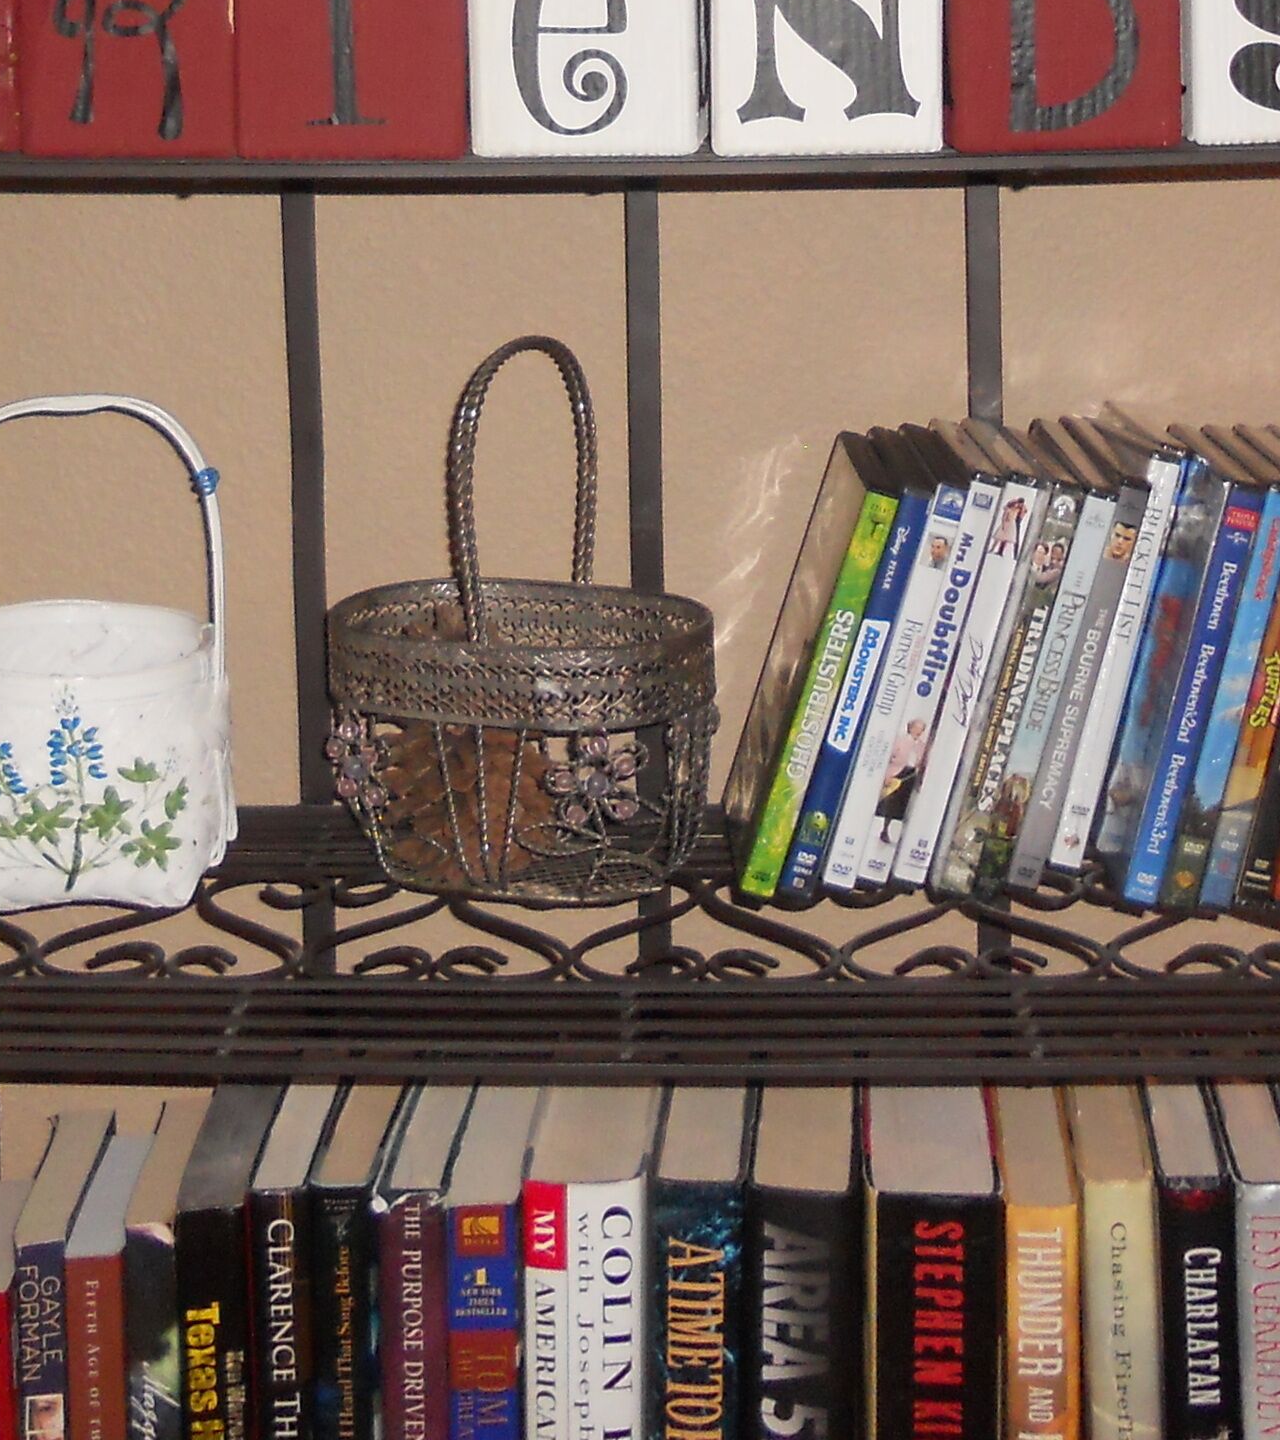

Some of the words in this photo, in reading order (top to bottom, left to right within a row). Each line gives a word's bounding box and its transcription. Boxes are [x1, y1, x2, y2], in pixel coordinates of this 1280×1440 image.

[889, 522, 911, 558] Disney
[953, 532, 975, 567] Mrs.
[1125, 506, 1164, 595] BUCKET
[881, 560, 897, 590] PIXAR
[1074, 570, 1085, 589] THE
[1207, 560, 1238, 632] Beethoven
[892, 618, 924, 671] Forrest
[915, 567, 973, 701] Doubtfire
[1040, 589, 1087, 680] PRINCESS
[1095, 608, 1108, 629] THE
[1112, 599, 1141, 645] LIST
[1006, 603, 1050, 711] TRADING
[1069, 628, 1101, 702] BOURNE
[785, 606, 856, 783] GHOSTBUSTERS
[875, 669, 907, 718] Gump
[1024, 674, 1061, 735] BRIDE
[832, 715, 852, 744] INC.
[1037, 704, 1081, 810] SUPREMACY
[976, 718, 1017, 814] PLACES
[404, 1203, 421, 1239] THE
[533, 1209, 556, 1259] MY
[335, 1246, 351, 1293] Before
[578, 1213, 595, 1293] with
[668, 1236, 725, 1268] A
[1110, 1222, 1131, 1337] Chasing
[19, 1265, 41, 1382] FORMAN
[40, 1276, 63, 1365] GAYLE
[85, 1280, 100, 1334] FIFTH
[266, 1218, 296, 1382] CLARENCE
[339, 1297, 354, 1334] Song
[401, 1250, 424, 1351] PURPOSE
[455, 1308, 507, 1317] BESTSELLER
[601, 1206, 634, 1393] COLIN
[667, 1271, 725, 1368] TIME
[761, 1221, 831, 1381] AREA
[913, 1220, 965, 1385] STEPHEN
[1016, 1227, 1063, 1376] THUNDER
[1184, 1247, 1223, 1406] CHARLATAN
[88, 1344, 101, 1378] AGE
[186, 1301, 221, 1412] Texas
[226, 1351, 245, 1383] Ken
[336, 1339, 352, 1372] That
[574, 1314, 595, 1440] Joseph
[89, 1387, 101, 1406] OF
[129, 1361, 181, 1440] Magg
[274, 1392, 300, 1438] TH
[338, 1379, 353, 1425] Heard
[477, 1347, 508, 1426] TOM
[665, 1374, 724, 1425] TO
[1028, 1386, 1054, 1423] AND
[761, 1398, 829, 1439] 5
